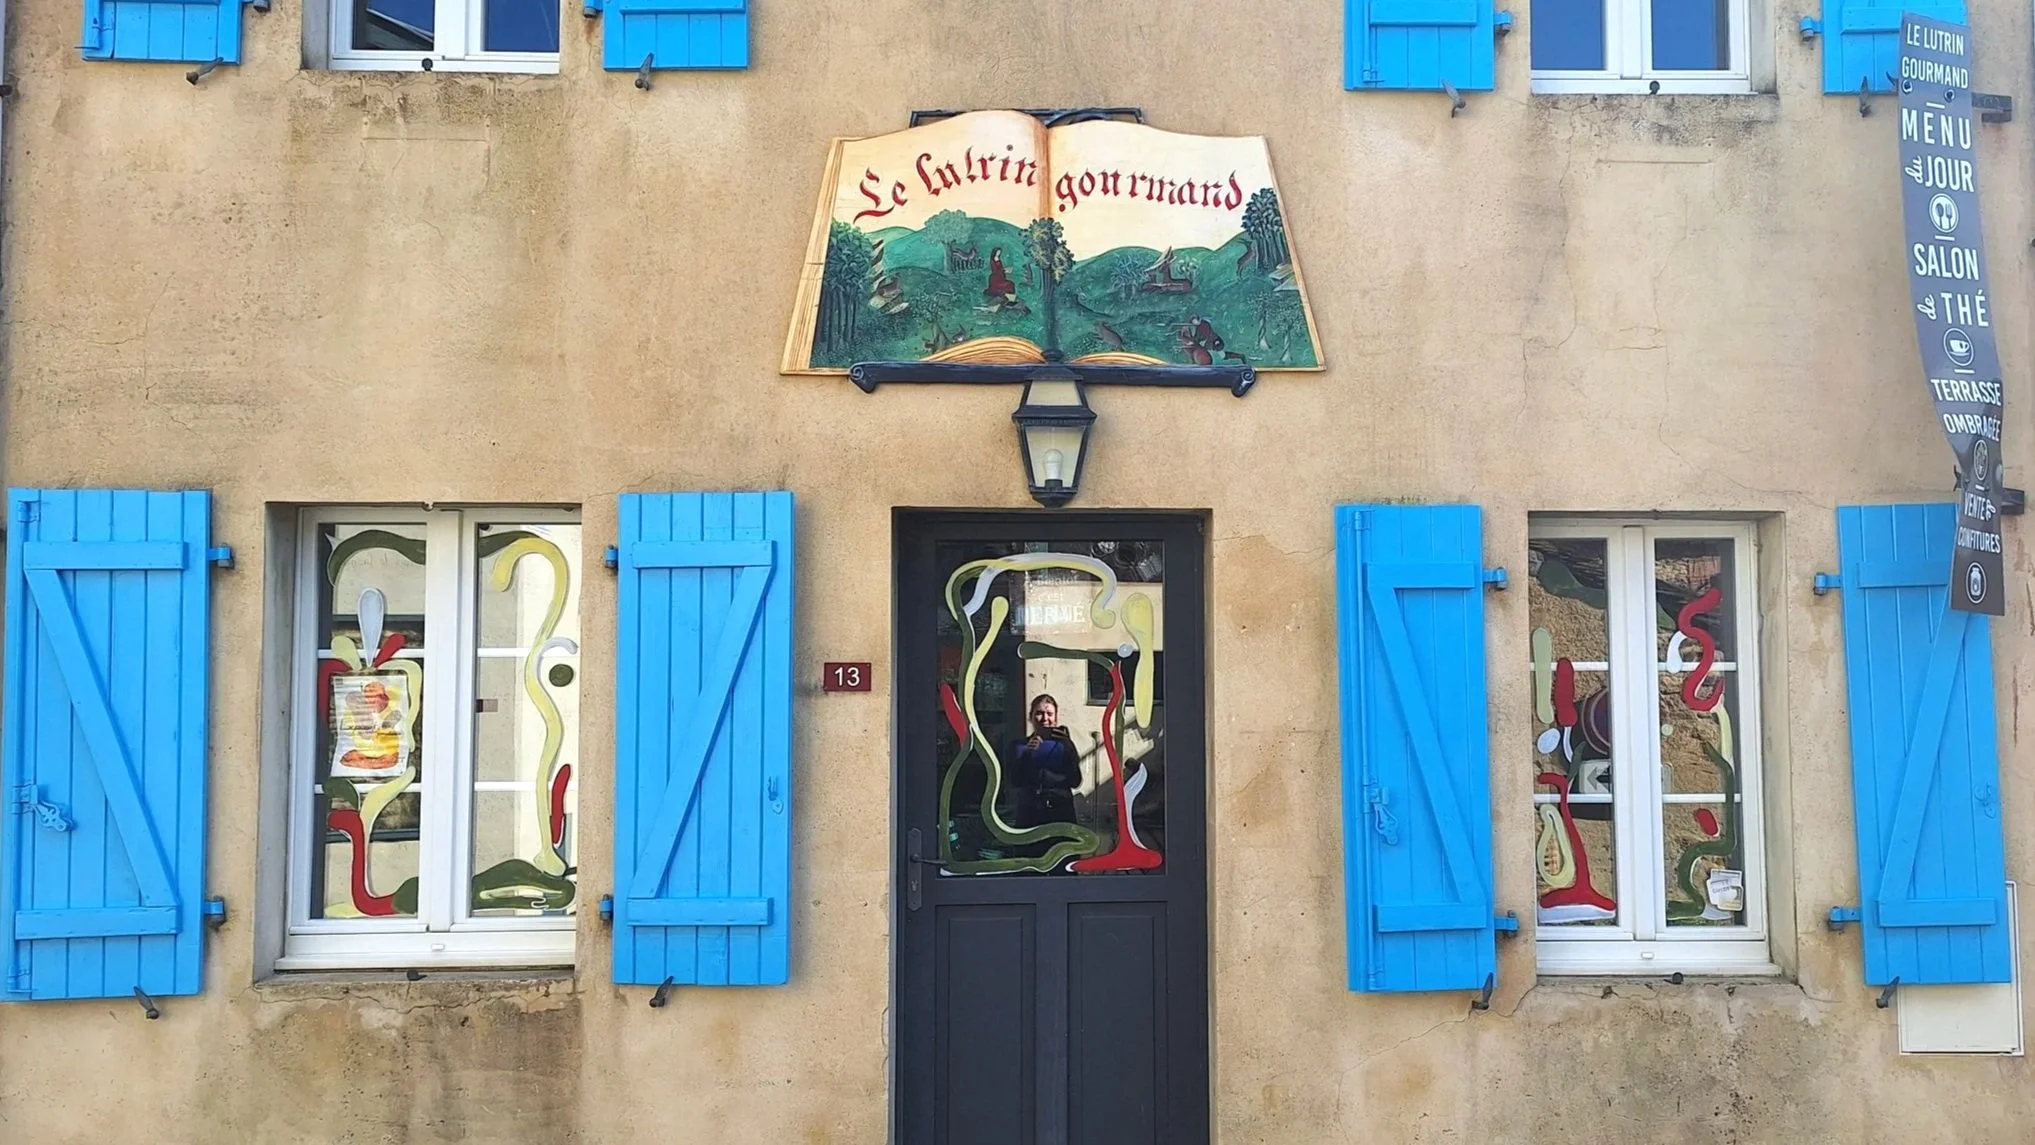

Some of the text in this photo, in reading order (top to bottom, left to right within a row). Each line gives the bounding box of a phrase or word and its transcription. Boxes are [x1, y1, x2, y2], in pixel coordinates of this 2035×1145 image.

[1906, 23, 1964, 56] LE LUTRIN
[1901, 56, 1969, 89] GOURMAND
[1901, 107, 1972, 150] MENU
[1904, 155, 1974, 193] du JOUR
[853, 167, 908, 225] Le
[1055, 168, 1243, 212] gourmand
[1913, 243, 1979, 281] SALON
[1916, 289, 1989, 327] de THÉ
[1930, 378, 2002, 406] TERRASSE
[1943, 413, 2001, 442] OMBRAGÉE
[1964, 492, 1985, 521] VENTE
[1957, 526, 2001, 554] CONFITURES
[834, 666, 860, 687] 13
